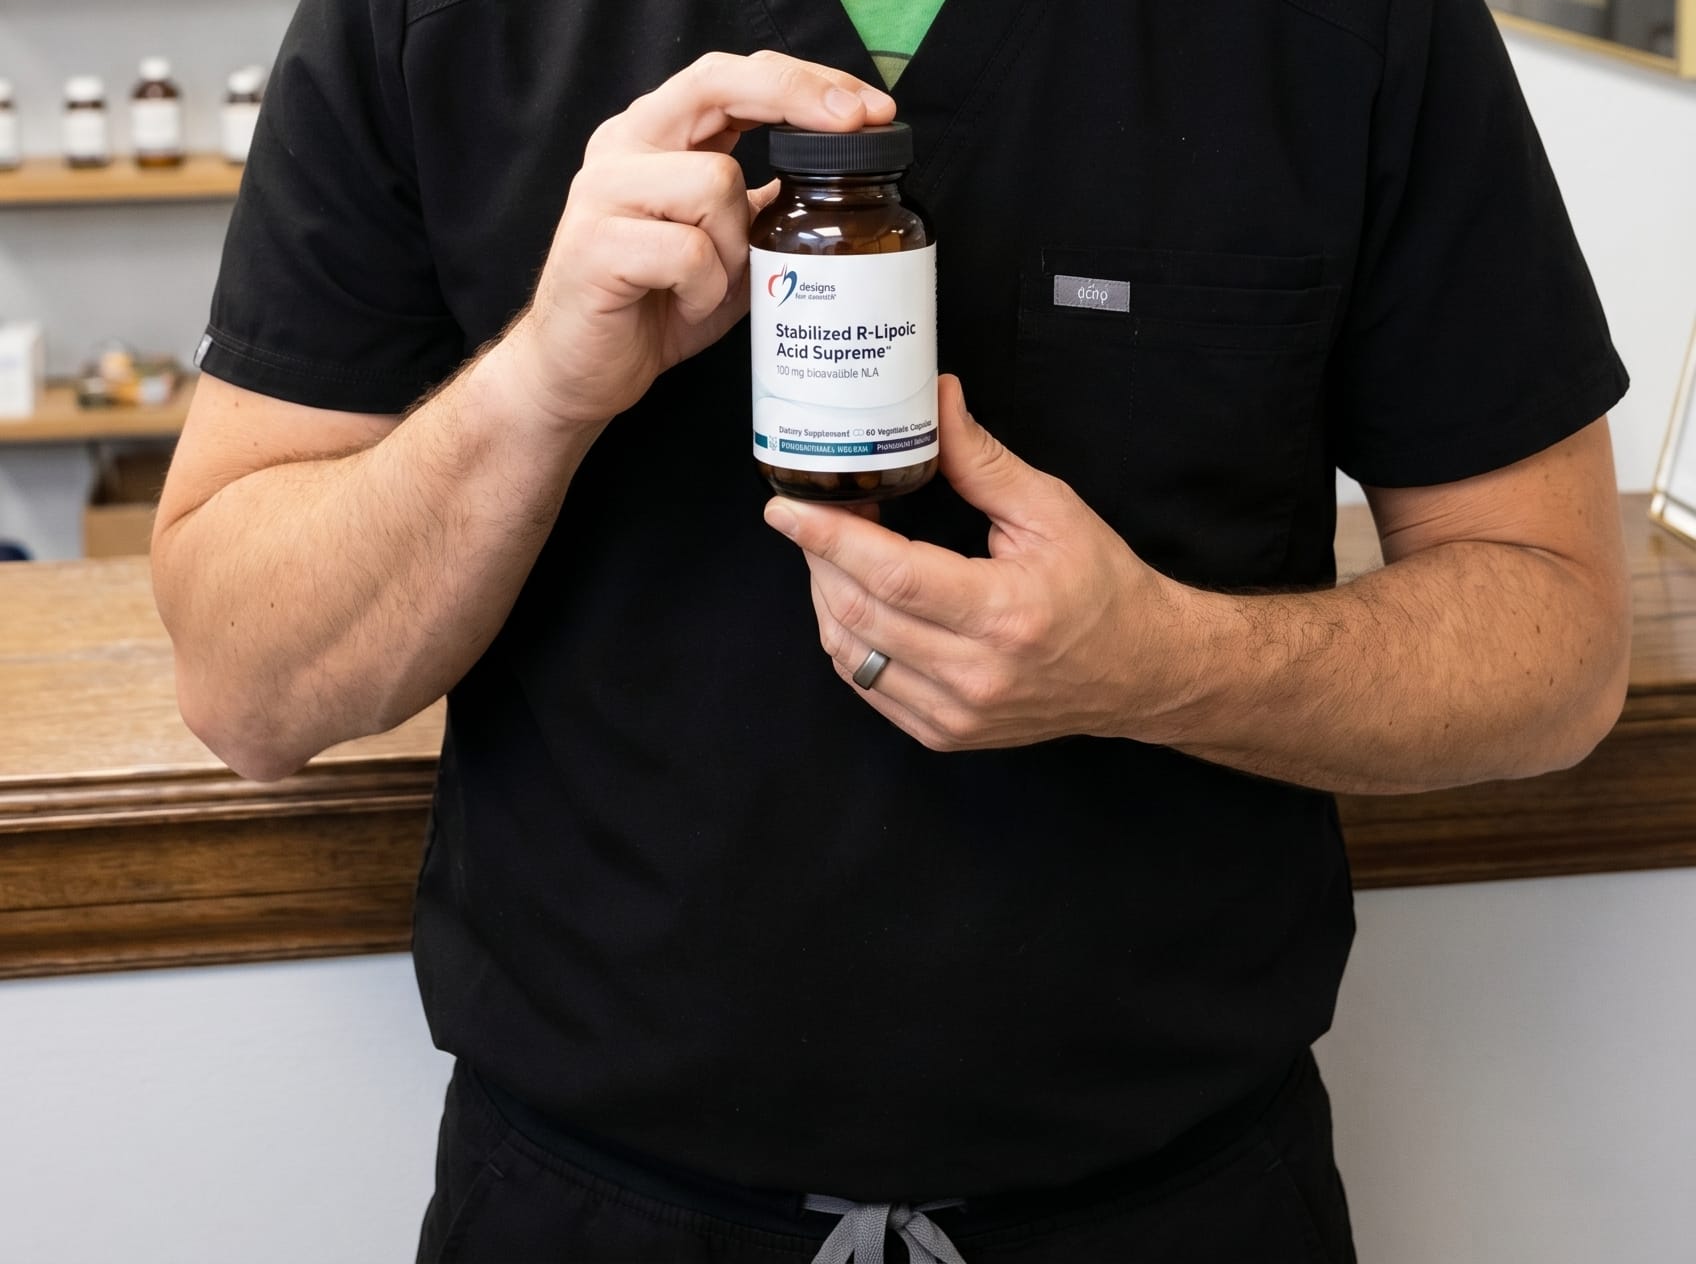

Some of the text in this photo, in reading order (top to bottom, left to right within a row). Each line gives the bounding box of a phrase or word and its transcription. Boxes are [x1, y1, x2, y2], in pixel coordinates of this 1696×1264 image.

[799, 282, 836, 294] designs
[776, 321, 916, 342] Stabilized R-Lipoic
[776, 342, 809, 359] Acid
[776, 365, 790, 376] 100
[791, 368, 805, 379] mg
[865, 429, 876, 437] 60
